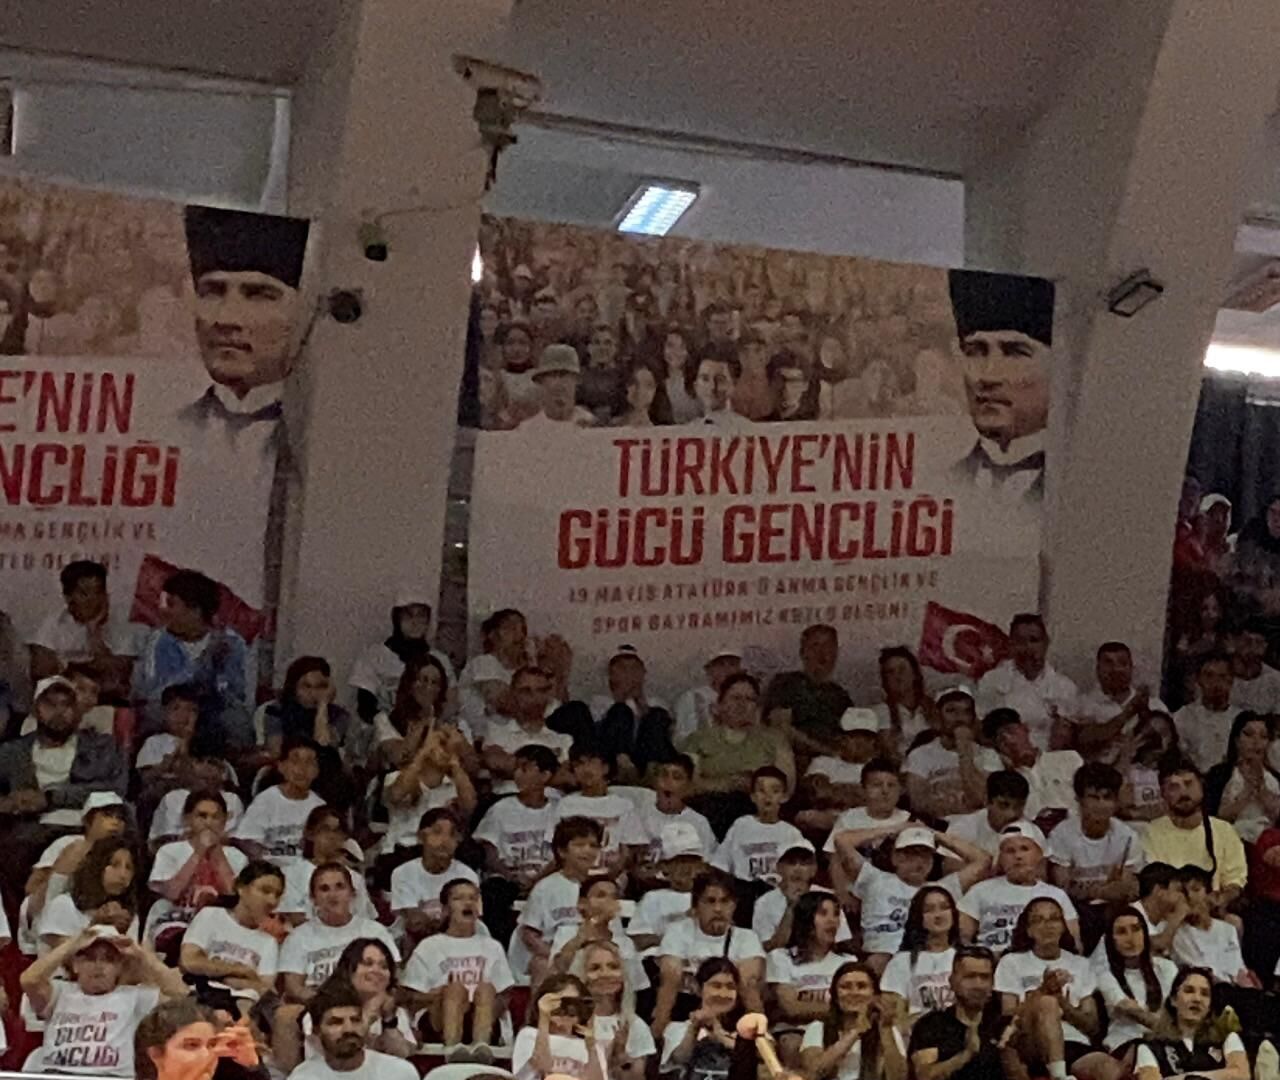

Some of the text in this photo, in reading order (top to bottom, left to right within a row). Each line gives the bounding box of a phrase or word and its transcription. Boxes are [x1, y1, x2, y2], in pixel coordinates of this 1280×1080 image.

[0, 370, 135, 434] E'NİN
[0, 439, 181, 512] NÇLİĞİ
[613, 432, 915, 498] TÜRKİYE'NİN
[558, 493, 953, 569] GÜCÜ GENÇLİĞİ
